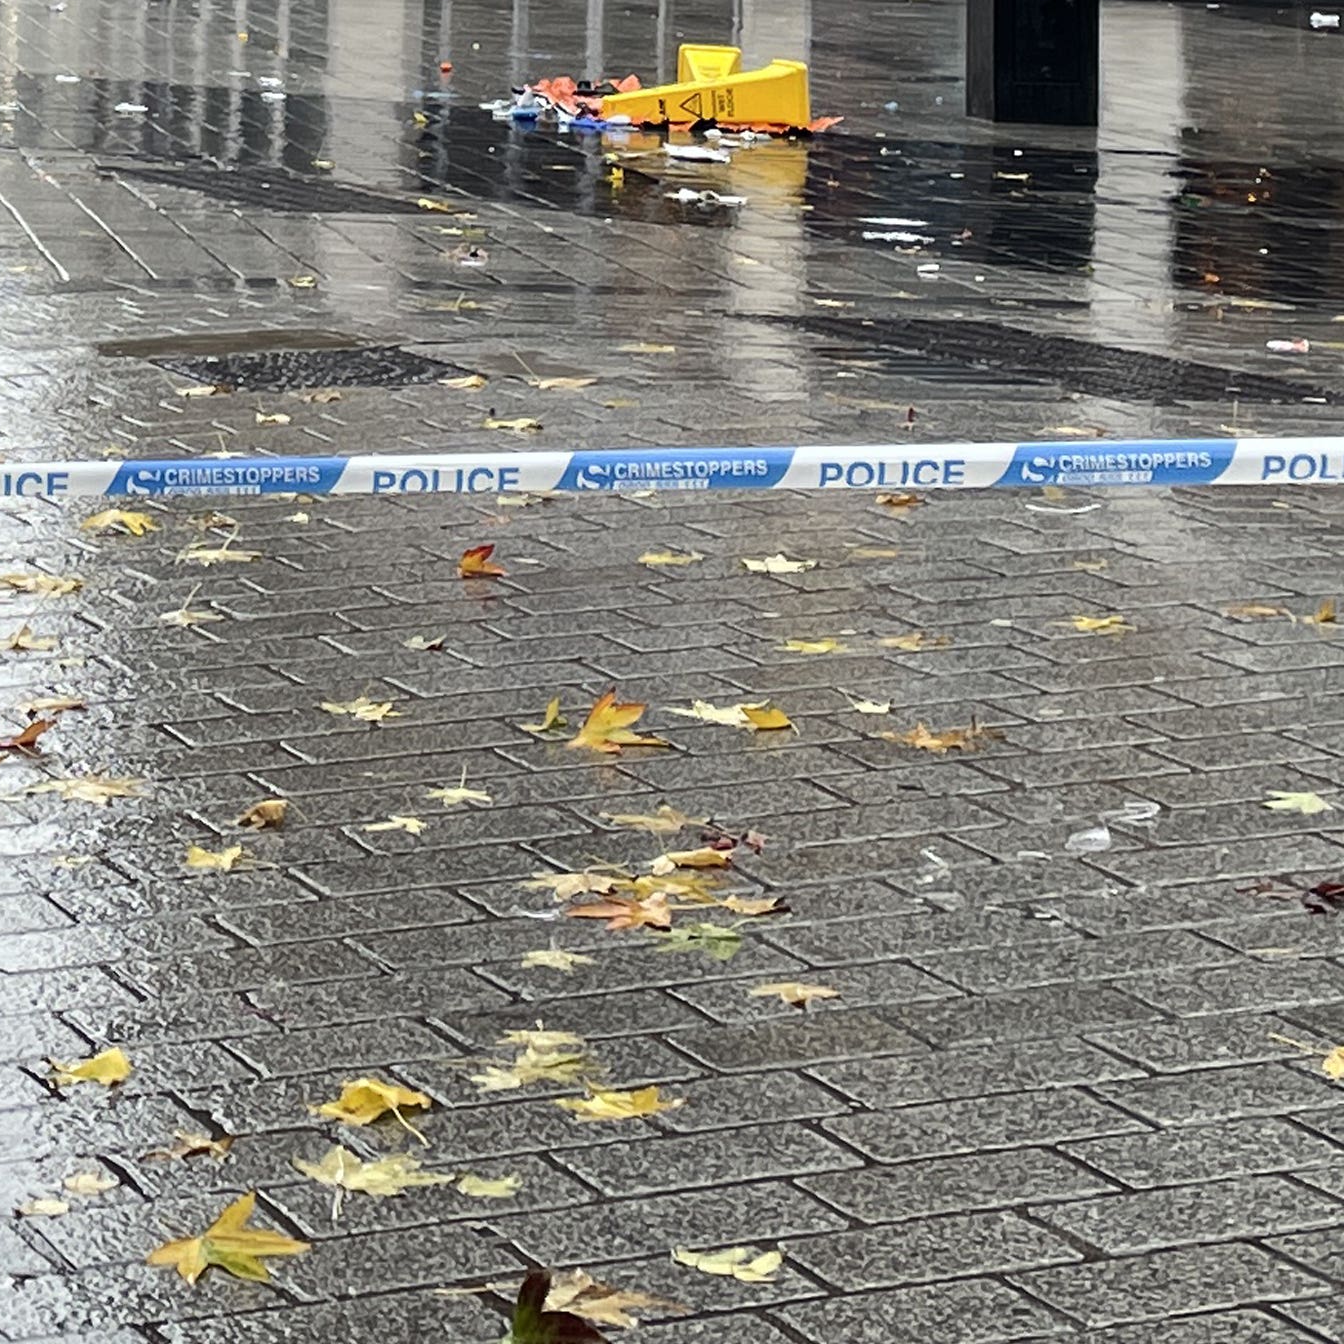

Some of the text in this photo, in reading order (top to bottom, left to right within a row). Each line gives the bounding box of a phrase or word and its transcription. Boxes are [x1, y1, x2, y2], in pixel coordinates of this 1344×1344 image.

[614, 459, 768, 480] CRIMESTOPPERS
[820, 459, 966, 488] POLICE
[1058, 451, 1213, 473] CRIMESTOPPERS
[1262, 453, 1344, 481] POL
[163, 464, 320, 488] CRIMESTOPPERS
[373, 466, 520, 493] POLICE
